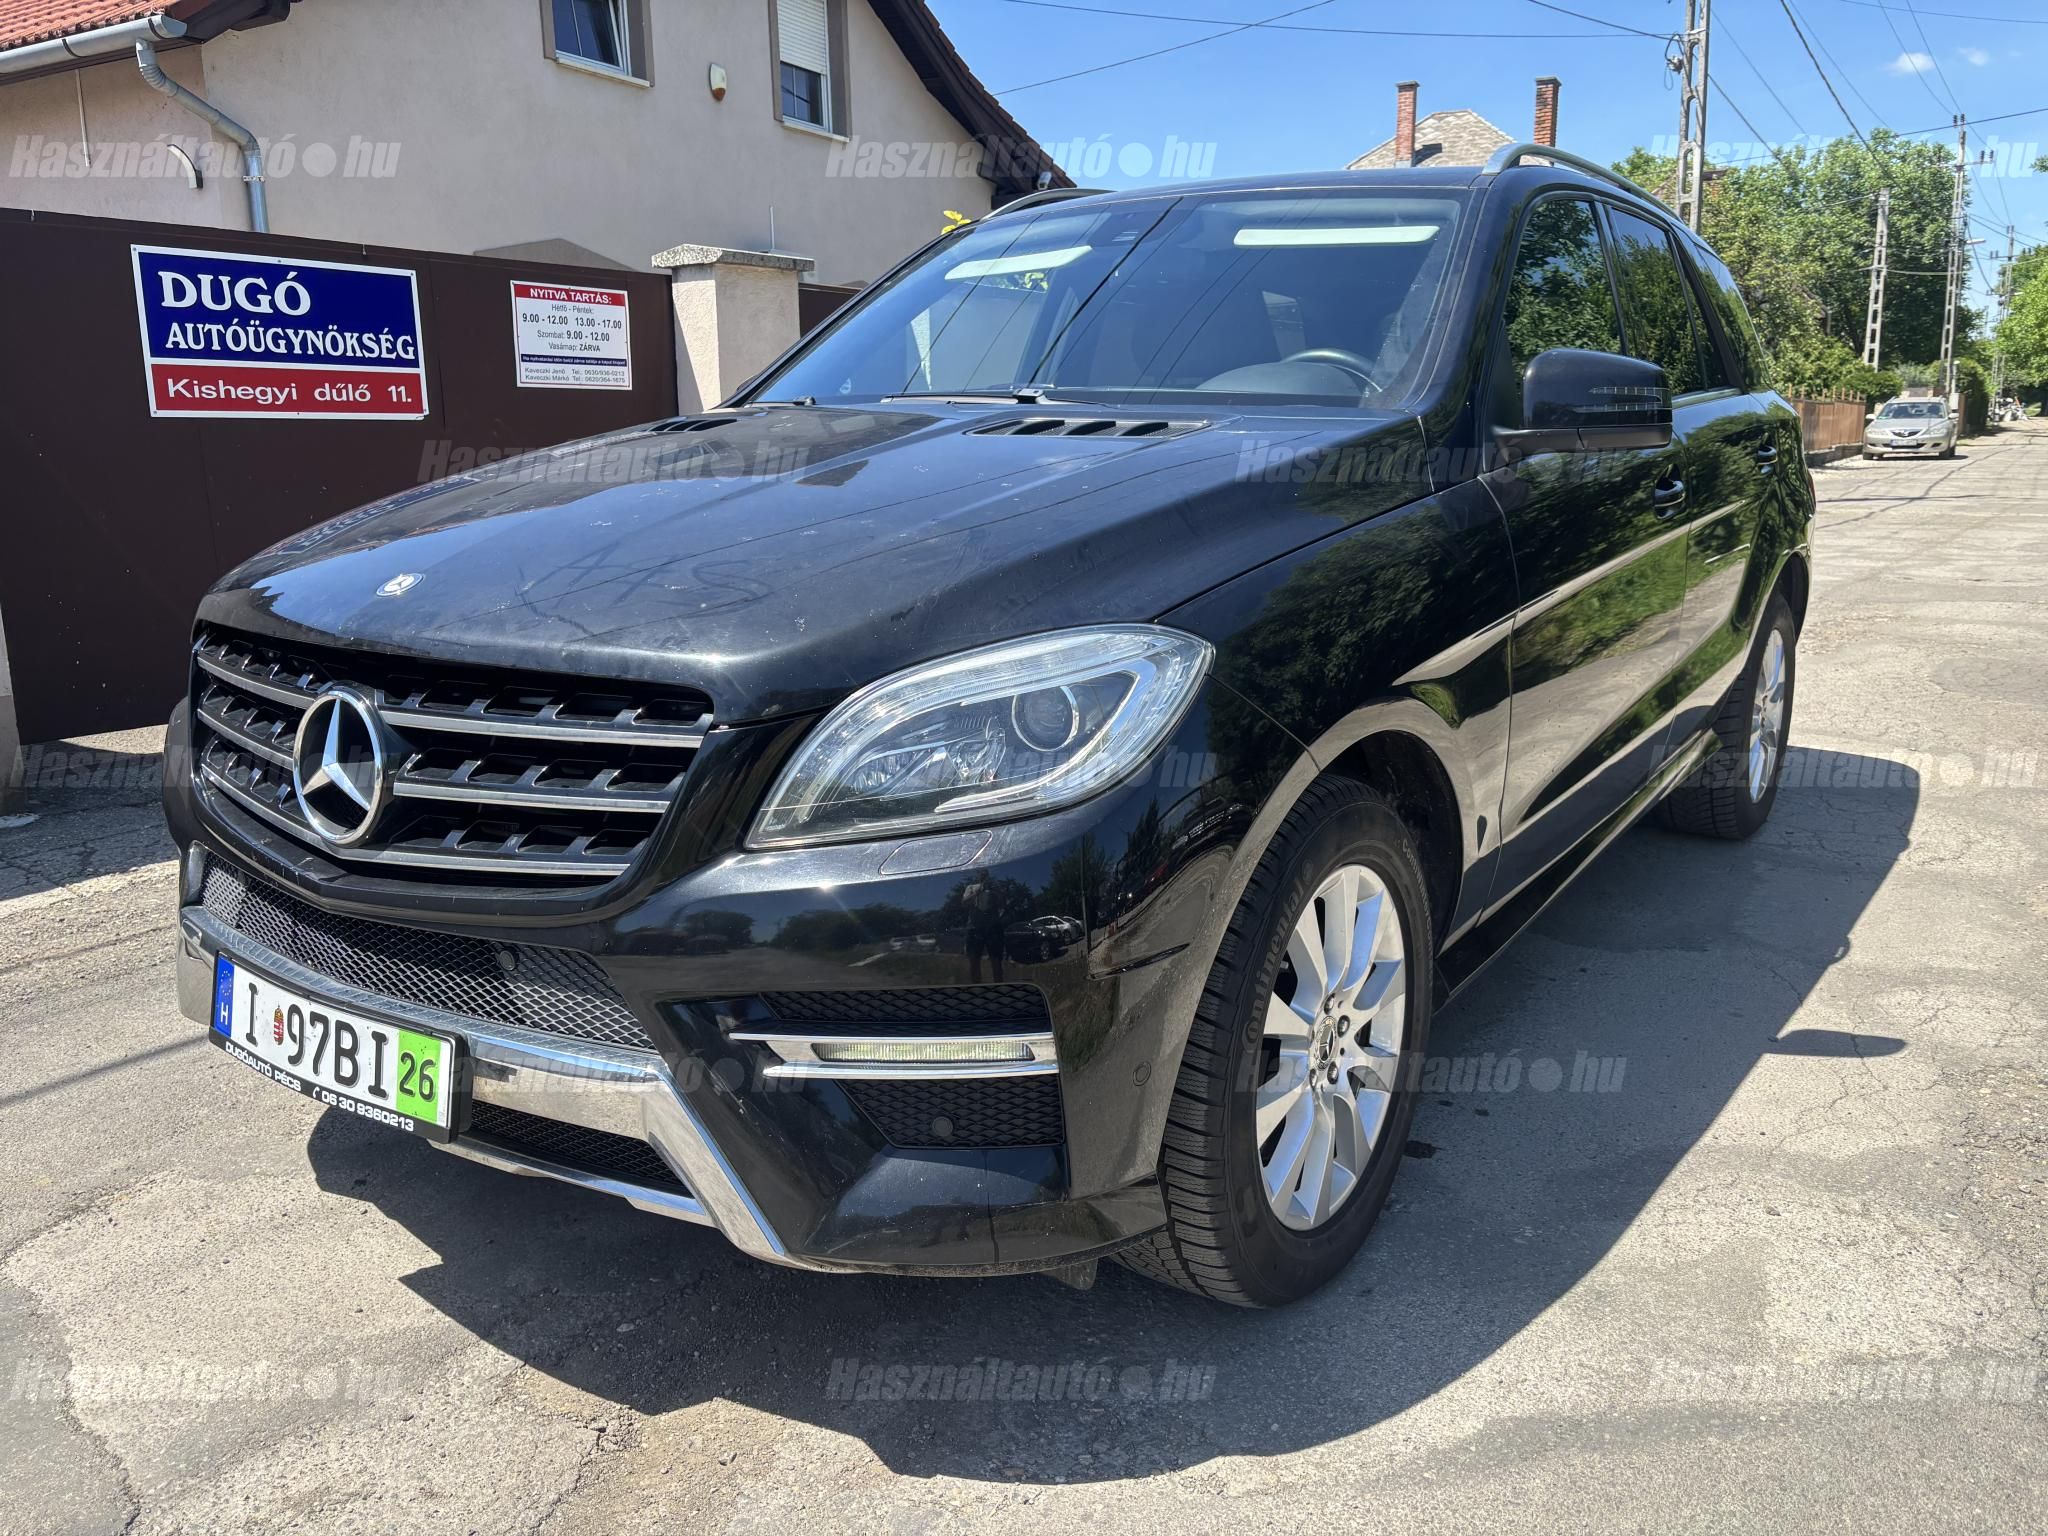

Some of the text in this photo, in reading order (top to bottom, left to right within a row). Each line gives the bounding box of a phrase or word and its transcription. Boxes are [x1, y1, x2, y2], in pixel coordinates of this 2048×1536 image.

[158, 271, 311, 316] DUGÓ
[530, 288, 612, 304] NYITVA TARTÁS:
[522, 313, 540, 323] 9.00
[547, 315, 568, 325] 12.00
[575, 317, 596, 327] 13.00
[603, 320, 622, 330] 17.00
[165, 318, 415, 360] AUTÓÜGYNÖKSÉG
[566, 330, 582, 340] 9.00
[591, 332, 610, 342] 12.00
[579, 343, 600, 352] ZÁRVA
[167, 378, 412, 405] Kishegyi dűlő 11.
[220, 1003, 228, 1025] H
[246, 982, 436, 1102] I 97BI 26
[226, 1041, 414, 1132] DUGÓAUTÓ PÉCS 06 30 9360213
